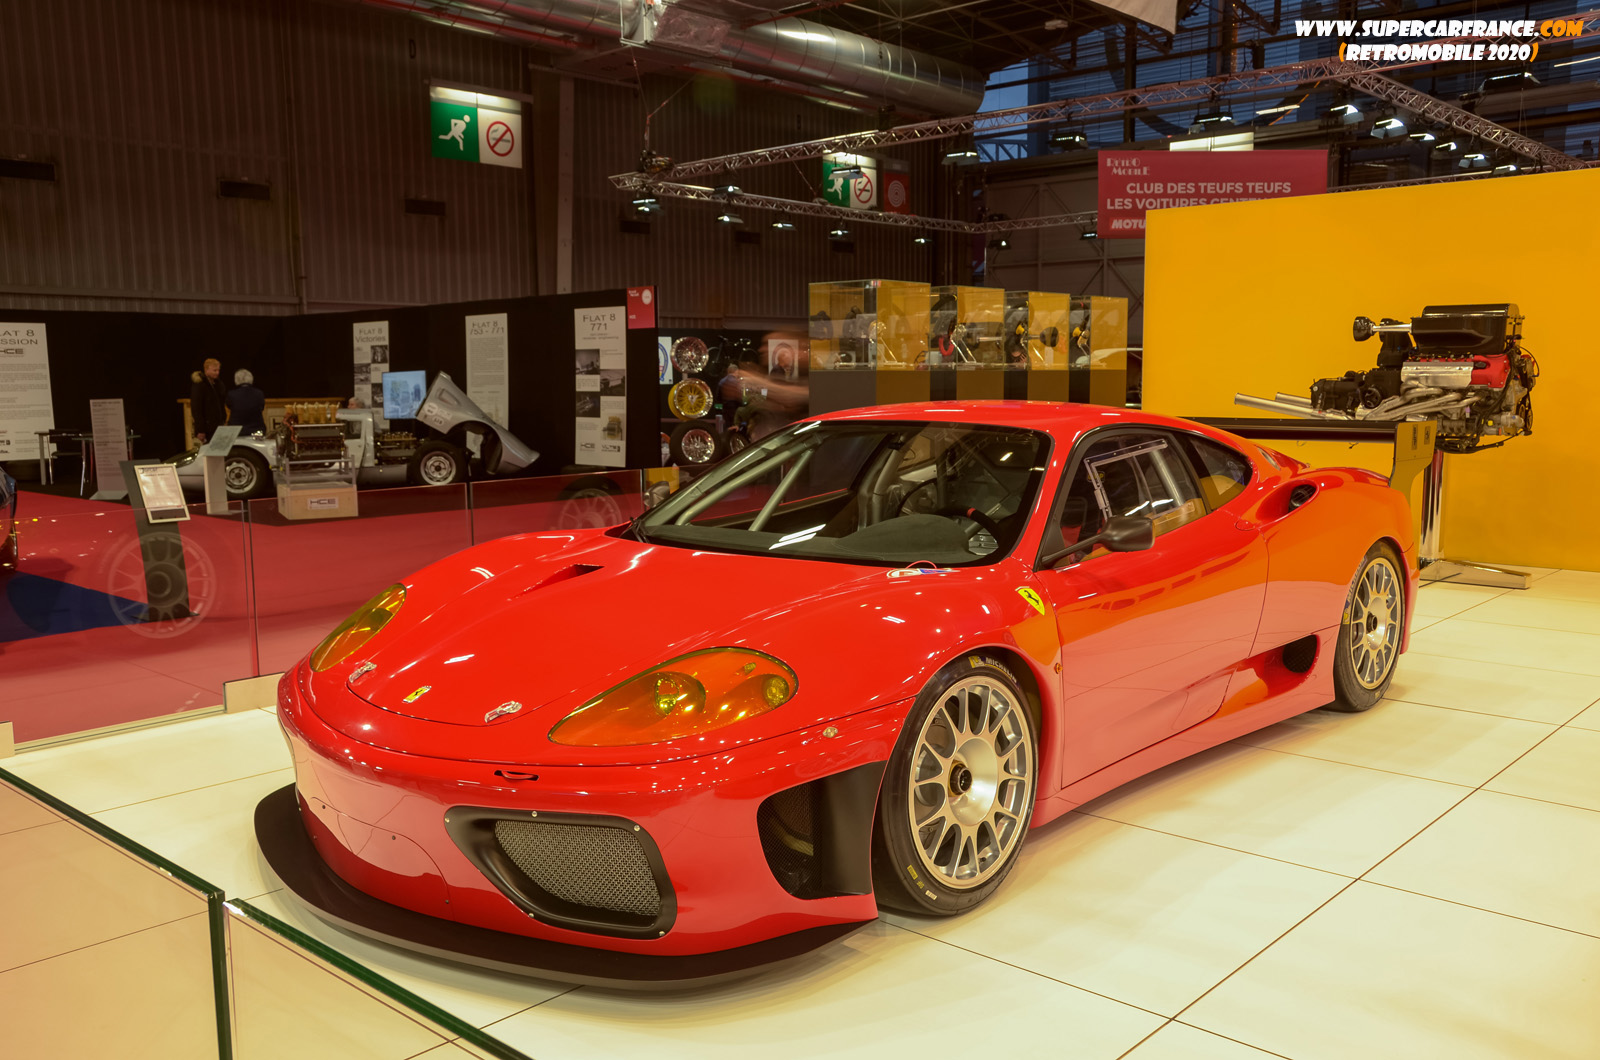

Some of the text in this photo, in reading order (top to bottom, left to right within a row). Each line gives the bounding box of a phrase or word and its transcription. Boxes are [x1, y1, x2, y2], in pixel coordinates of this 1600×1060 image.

[1126, 182, 1291, 194] CLUB DES TEUFS TEUFS
[1106, 198, 1132, 210] LES
[1111, 219, 1146, 229] MOTU
[583, 313, 616, 322] FLAT 8
[590, 323, 607, 331] 771
[26, 329, 35, 337] 8
